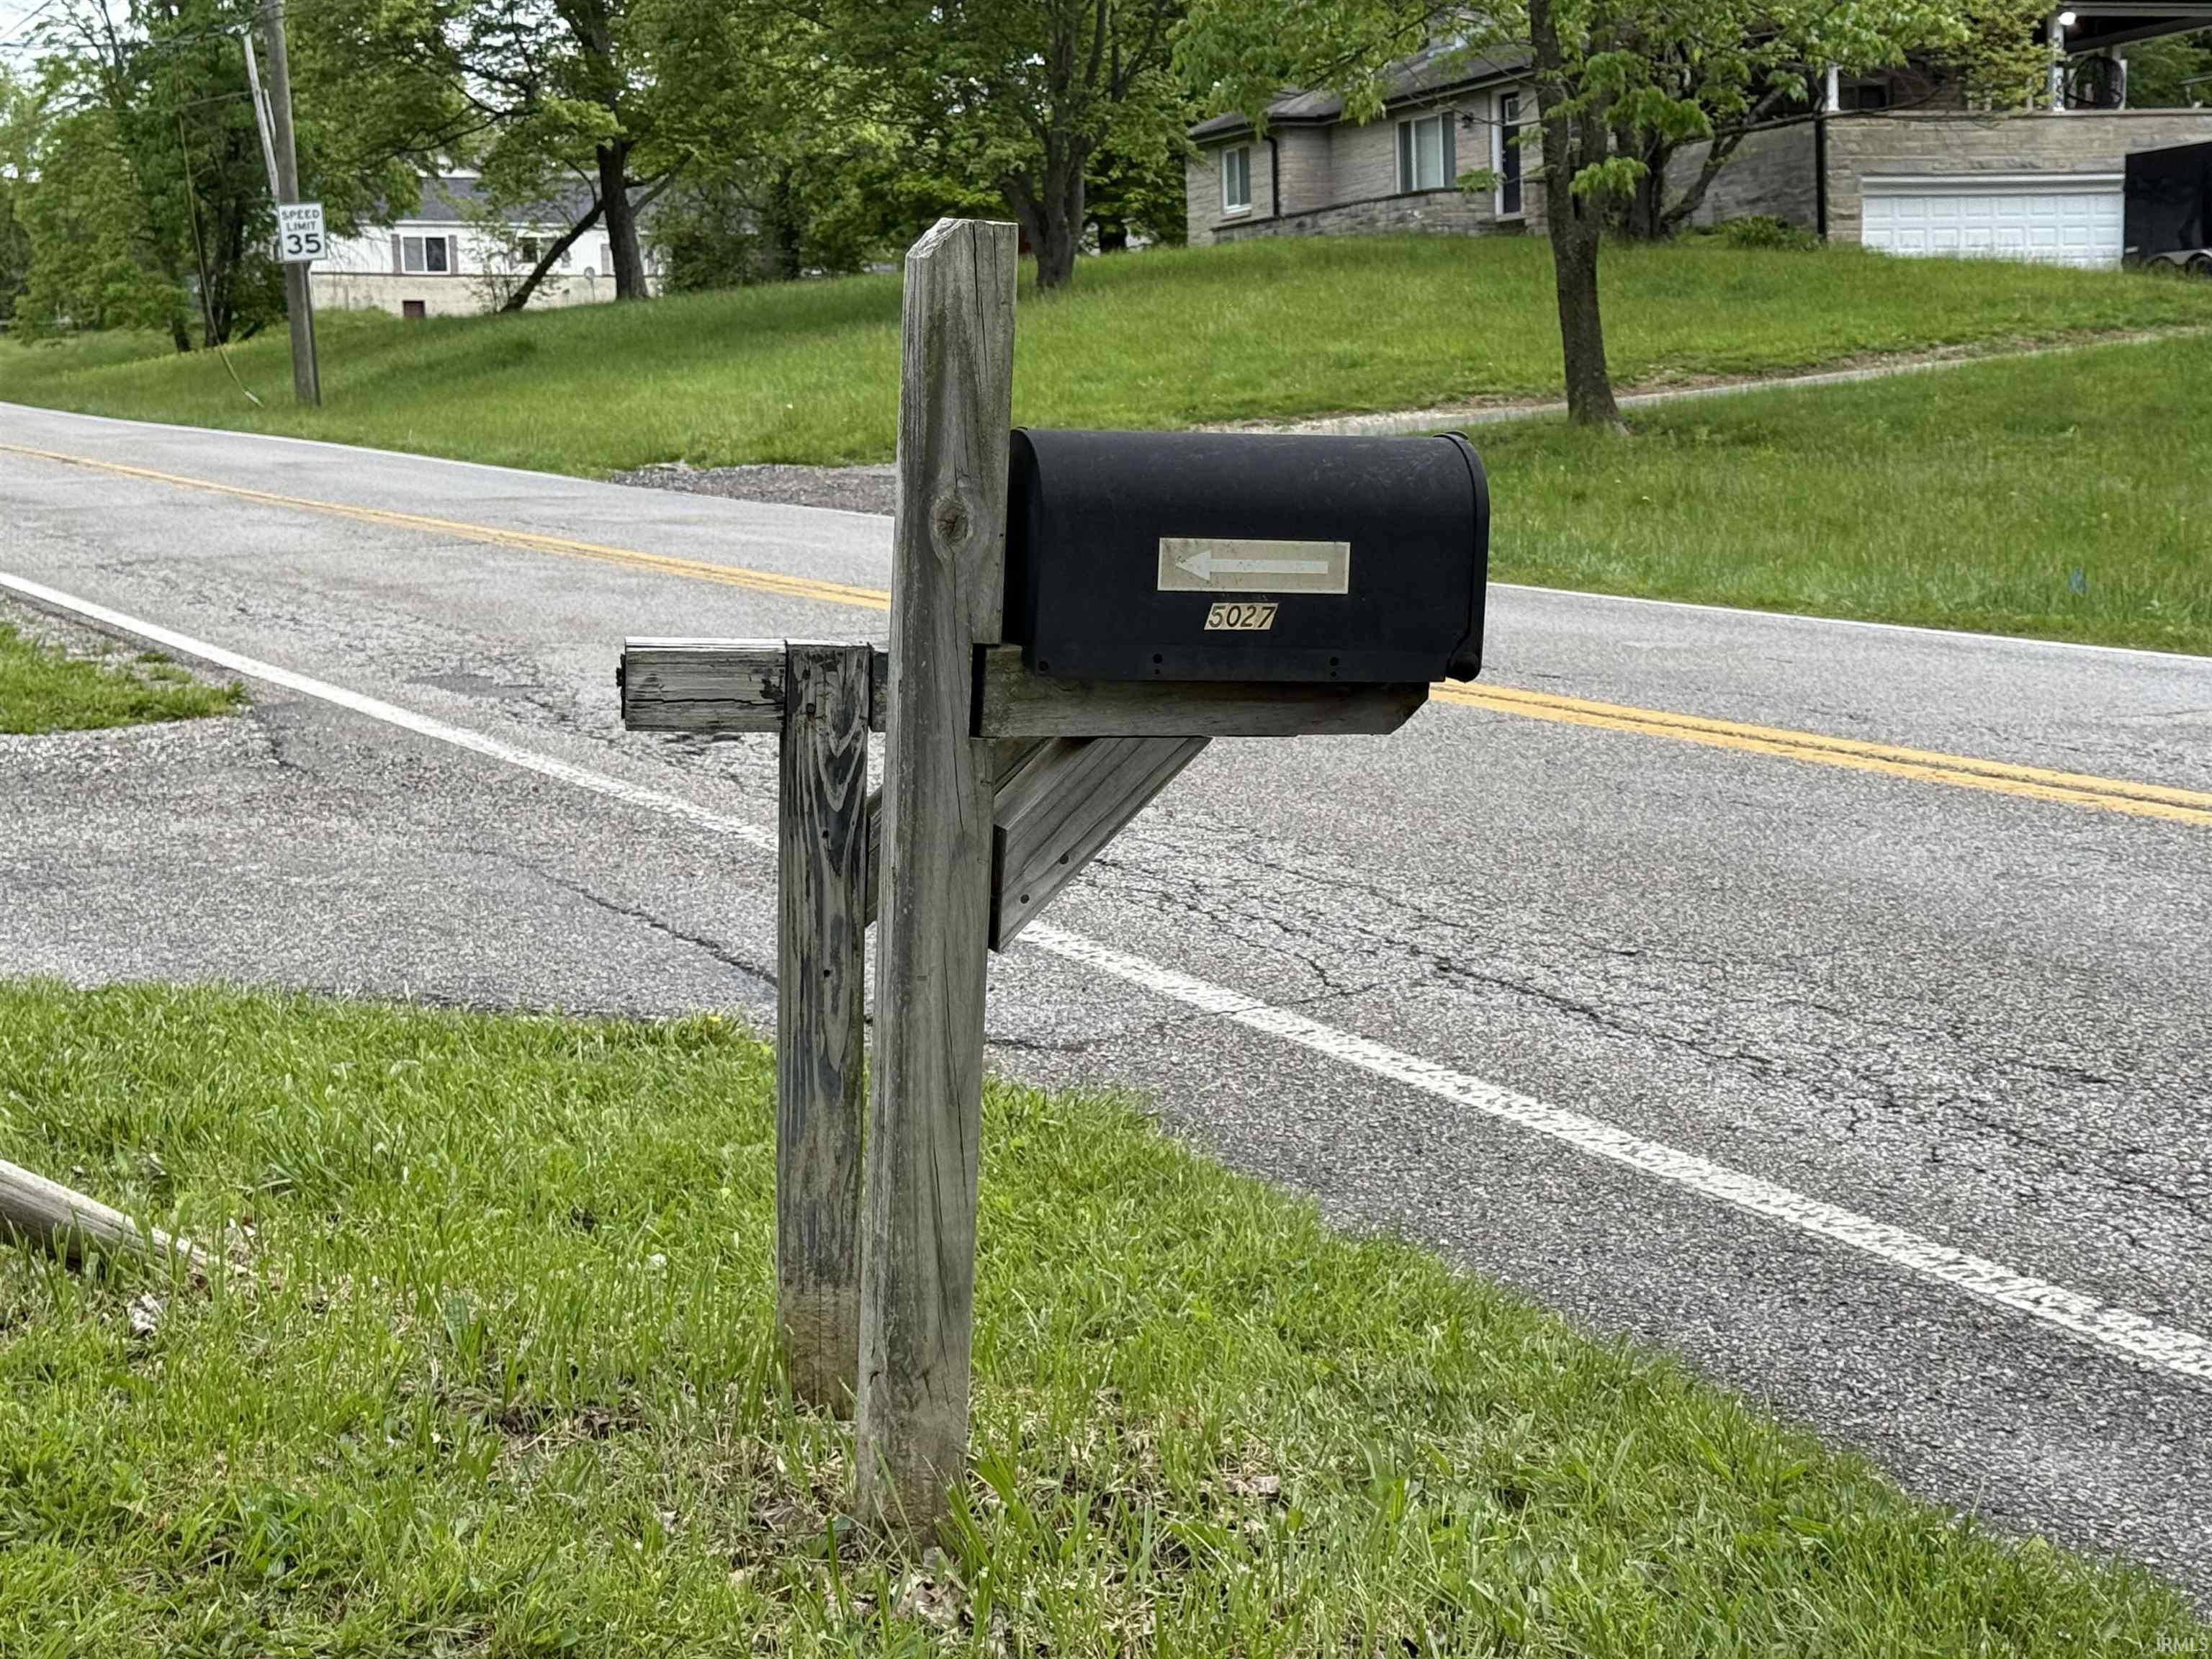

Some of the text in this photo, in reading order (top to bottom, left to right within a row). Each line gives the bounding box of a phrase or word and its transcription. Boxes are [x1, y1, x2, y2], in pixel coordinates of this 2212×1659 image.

[282, 210, 320, 220] SPEED
[286, 221, 316, 231] LIMIT
[287, 233, 321, 254] 35
[1208, 605, 1275, 629] 5027
